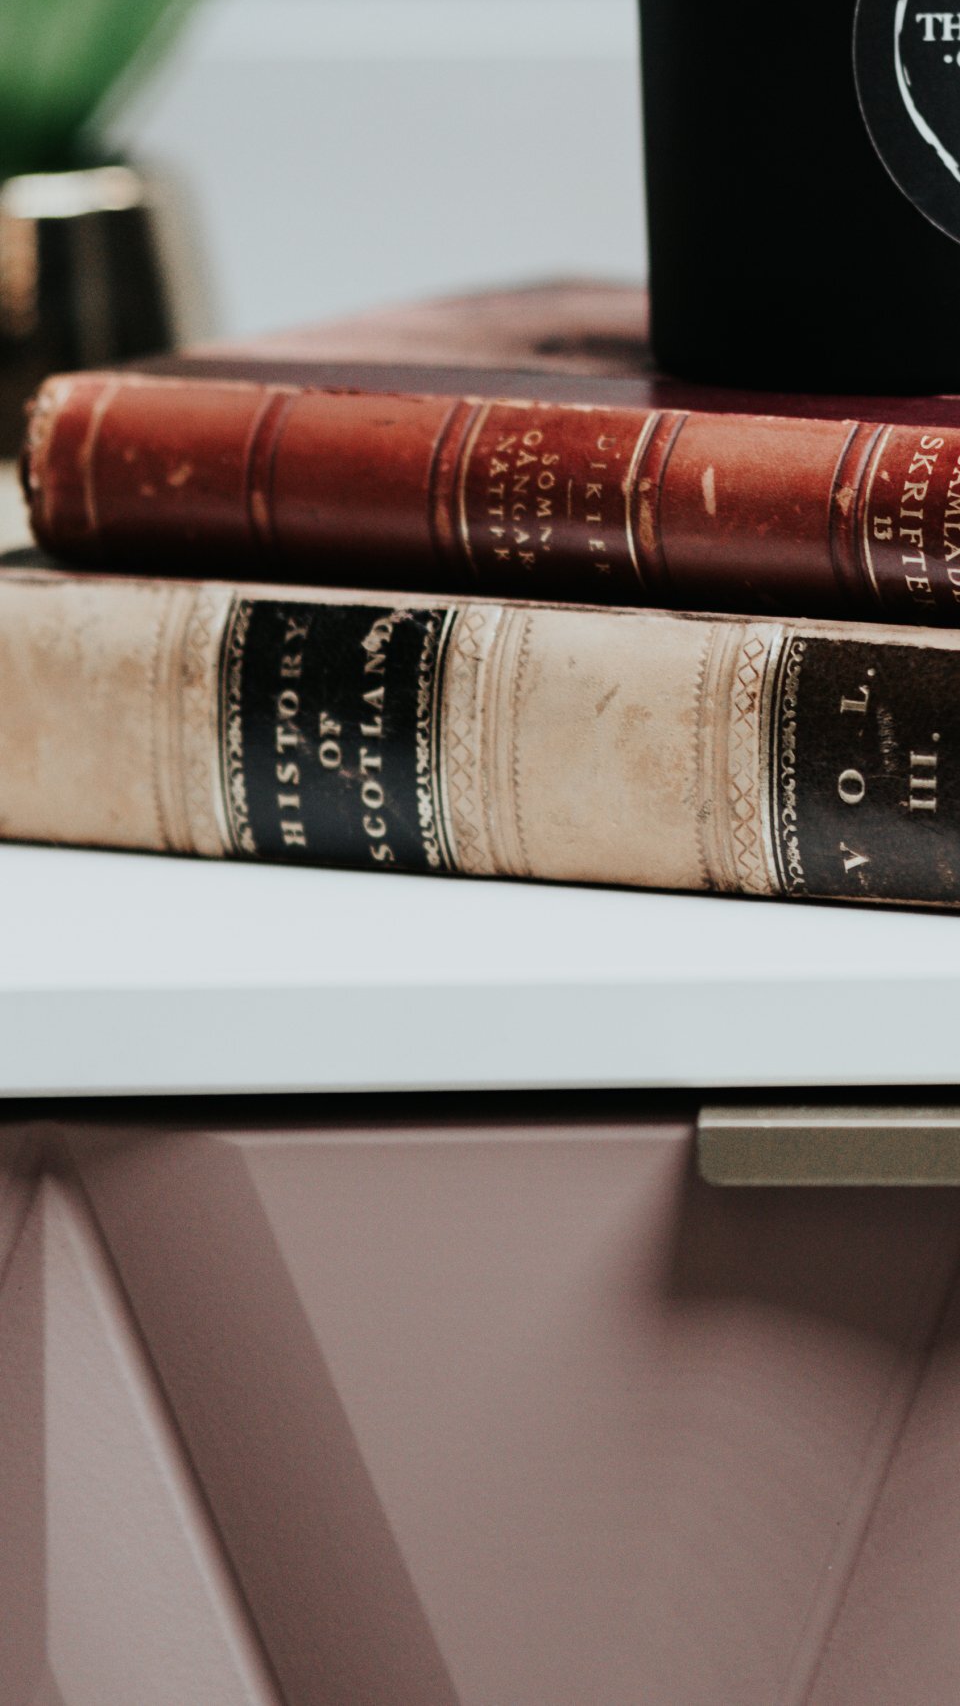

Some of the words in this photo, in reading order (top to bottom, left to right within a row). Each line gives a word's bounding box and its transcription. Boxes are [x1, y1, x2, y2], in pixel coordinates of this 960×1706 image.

[874, 516, 893, 542] 13
[900, 435, 945, 611] SKRIFTER
[276, 615, 309, 847] HISTORY
[319, 711, 342, 770] OF
[359, 615, 395, 862] SCOTLAND
